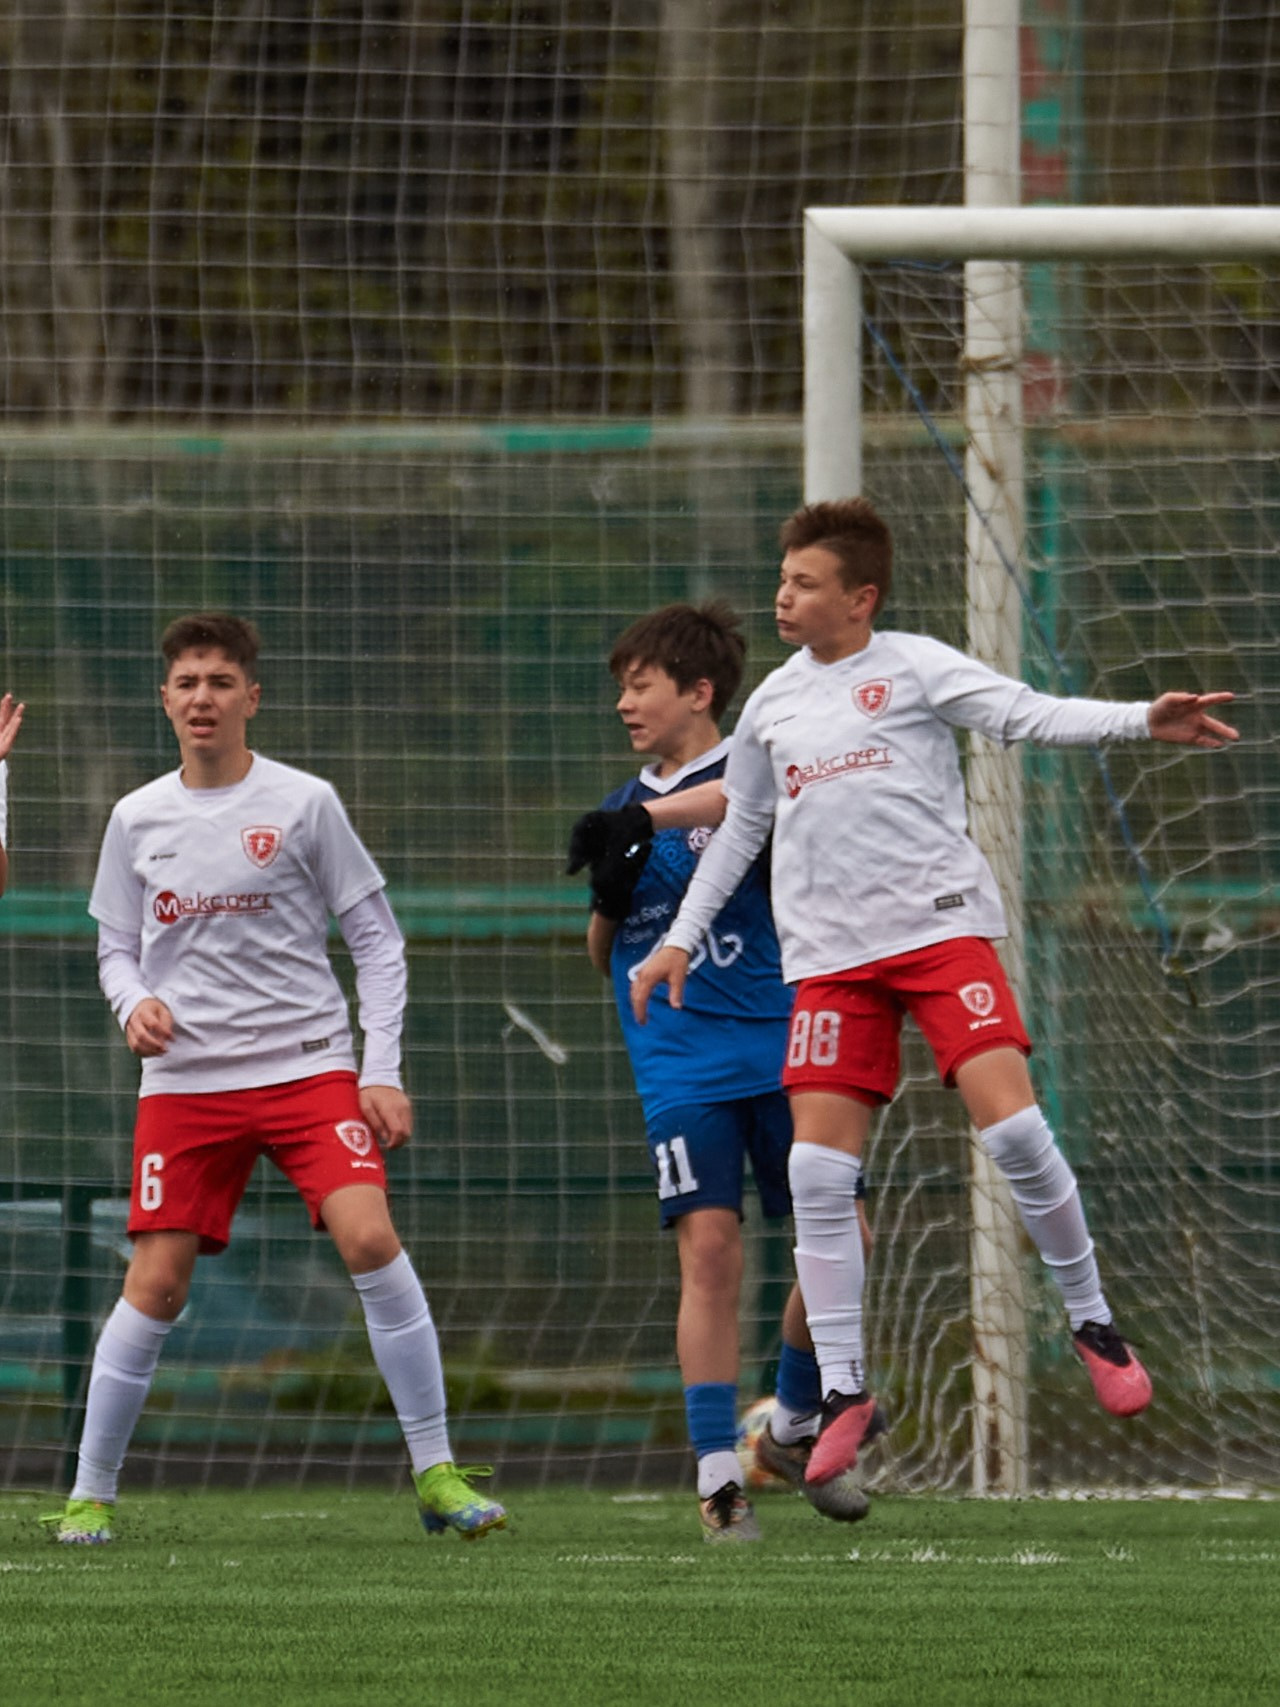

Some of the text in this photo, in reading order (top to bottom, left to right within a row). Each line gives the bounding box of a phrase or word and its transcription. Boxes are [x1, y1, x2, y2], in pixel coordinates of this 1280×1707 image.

[788, 1010, 841, 1067] 88
[140, 1153, 164, 1211] 6
[655, 1136, 700, 1200] 11
